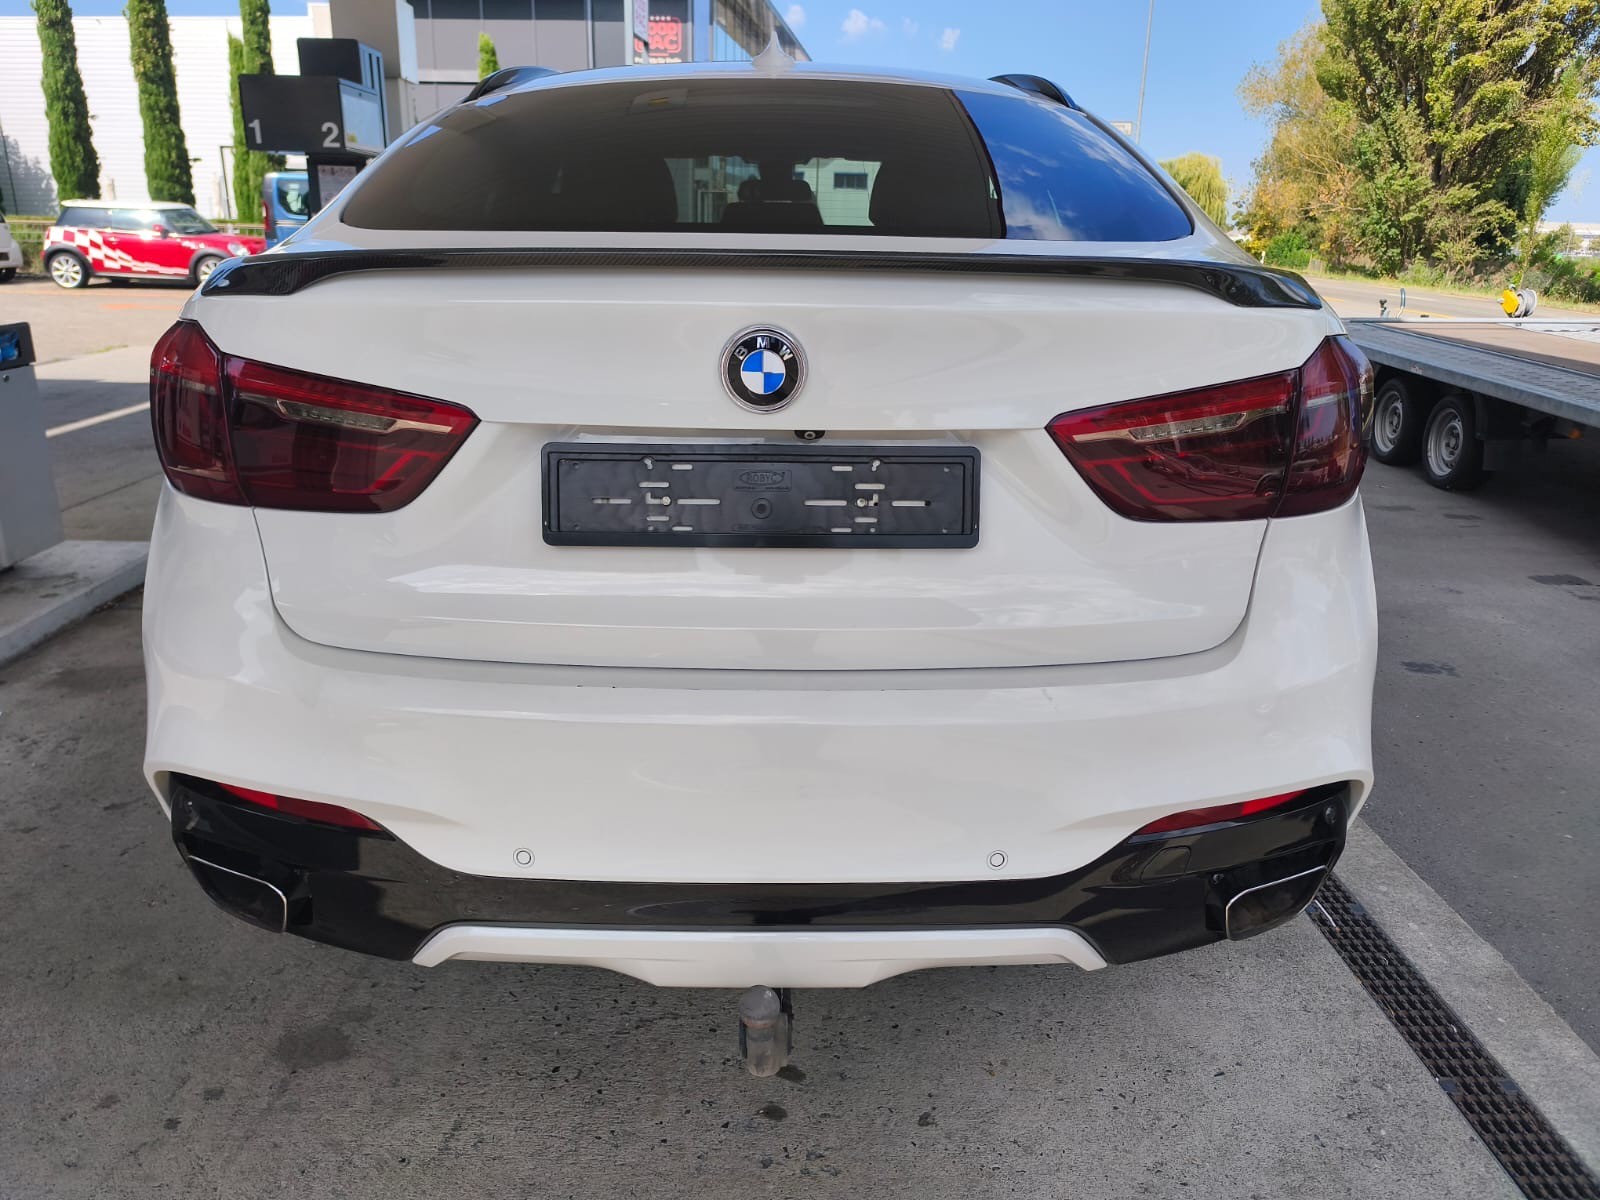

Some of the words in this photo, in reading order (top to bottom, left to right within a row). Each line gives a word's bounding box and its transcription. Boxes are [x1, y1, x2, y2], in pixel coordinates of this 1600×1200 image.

[248, 119, 262, 144] 1
[321, 122, 341, 148] 2
[733, 337, 794, 361] BMW
